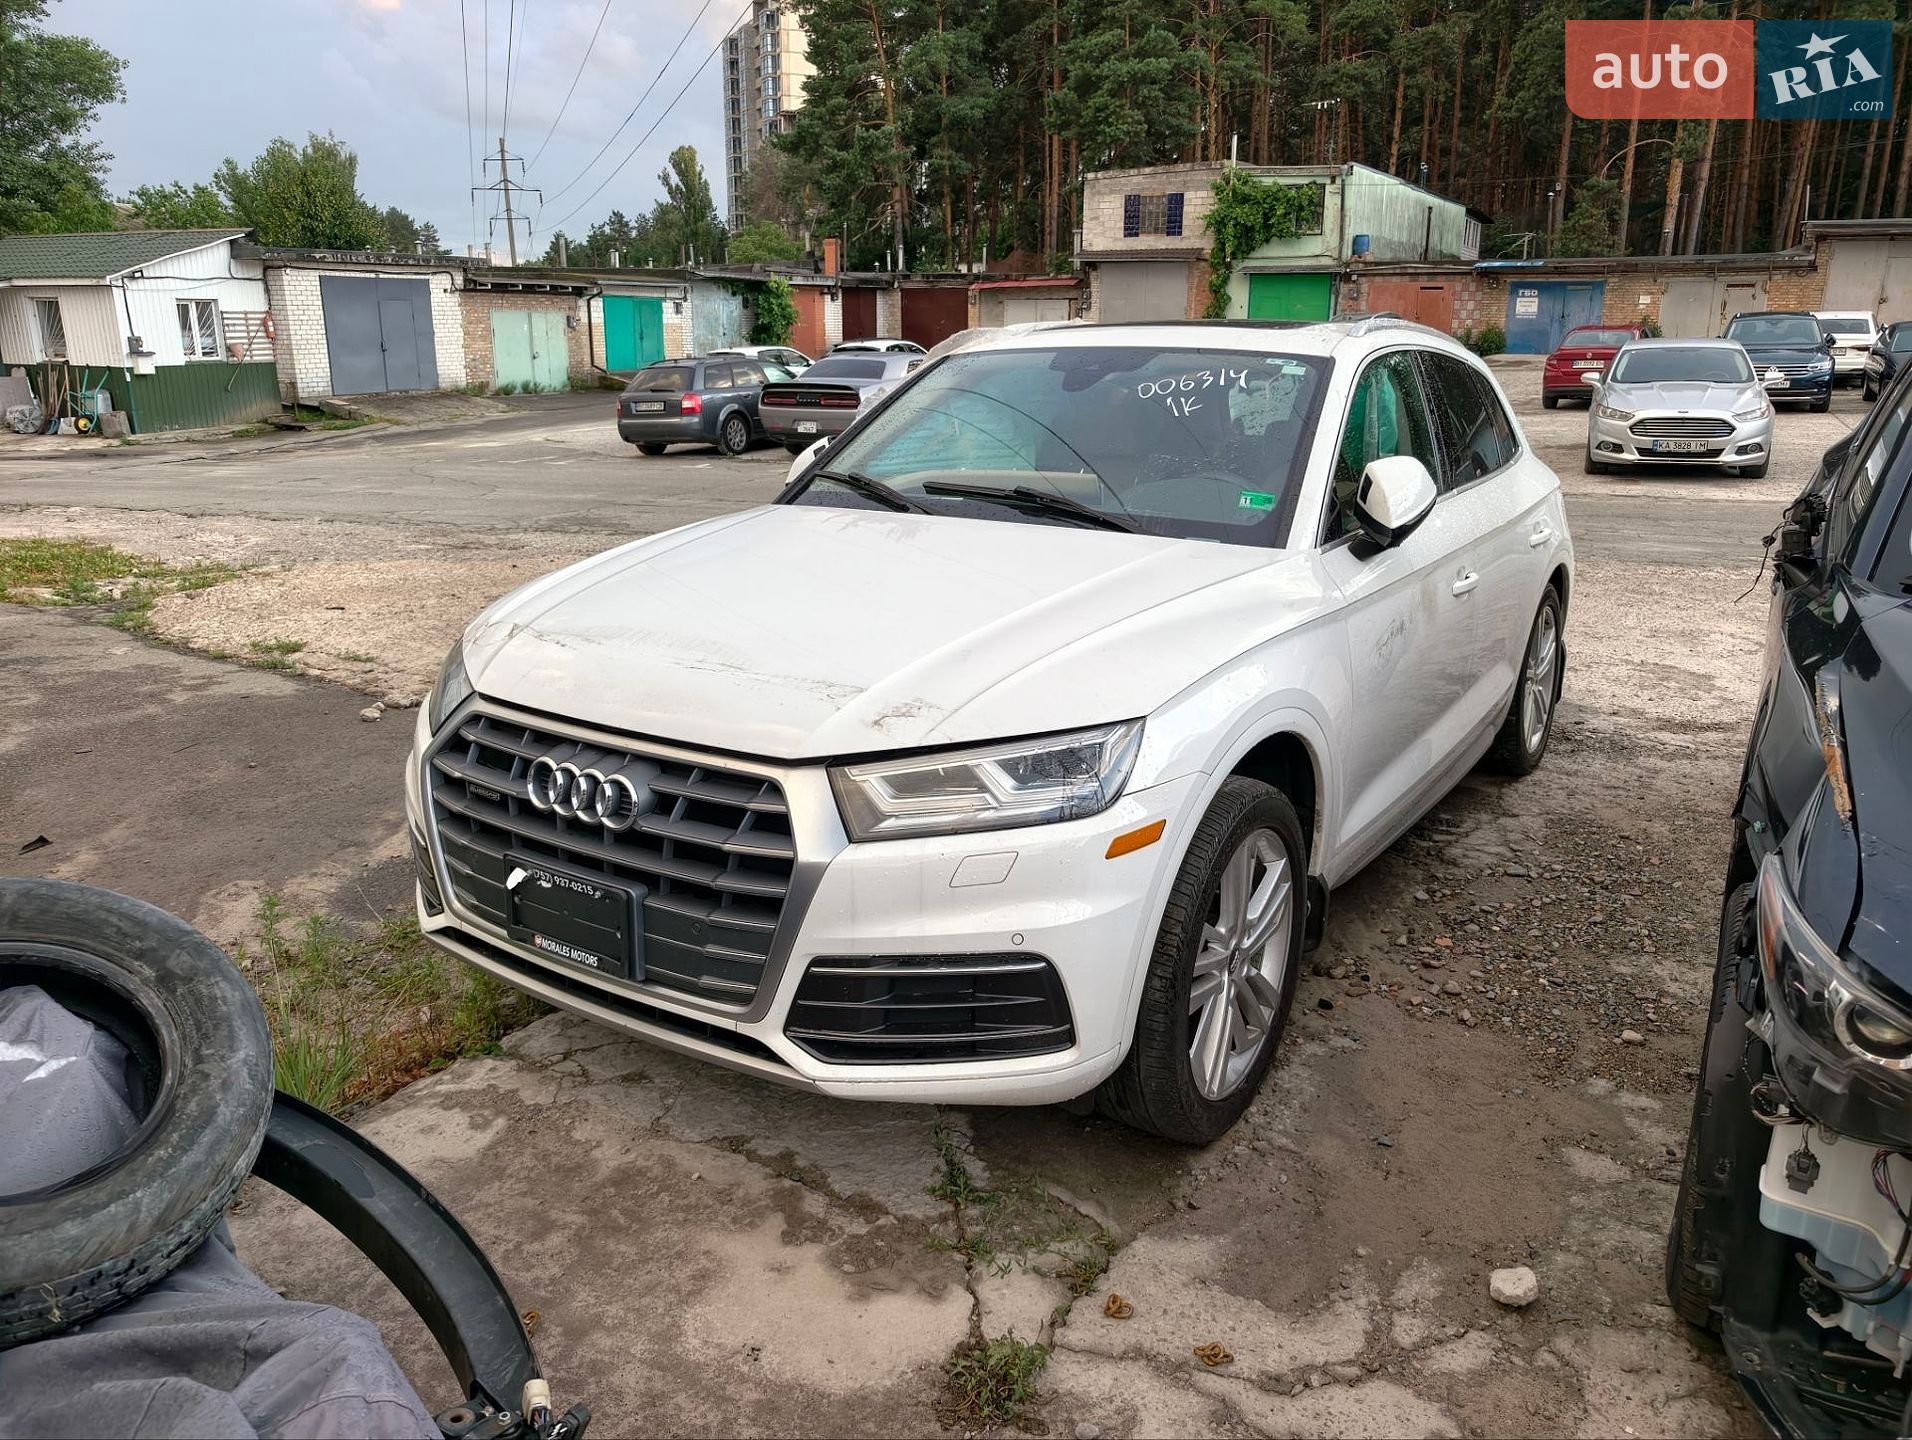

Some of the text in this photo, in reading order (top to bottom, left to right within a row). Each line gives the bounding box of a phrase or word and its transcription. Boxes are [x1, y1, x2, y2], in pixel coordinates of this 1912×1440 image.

[1138, 368, 1248, 399] 006314
[1658, 441, 1670, 450] KA
[1673, 441, 1692, 450] 3828
[541, 937, 598, 967] MORALES MOTORS
